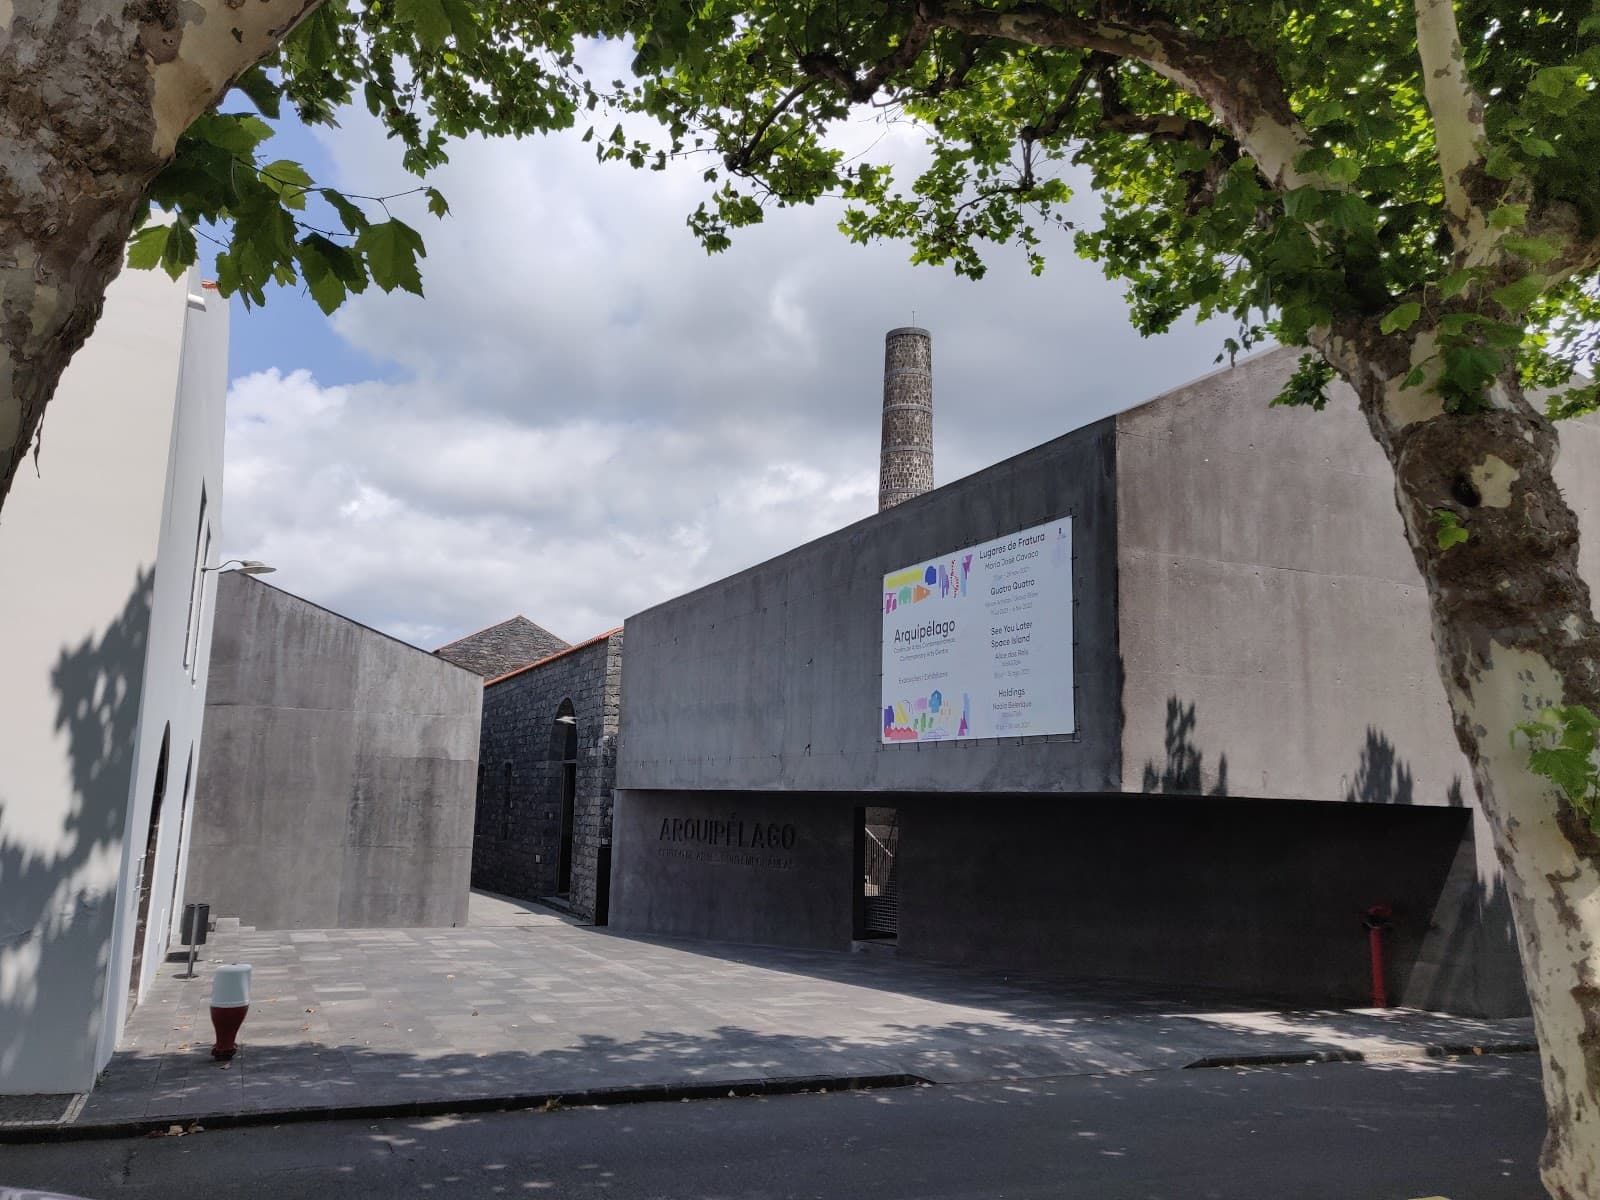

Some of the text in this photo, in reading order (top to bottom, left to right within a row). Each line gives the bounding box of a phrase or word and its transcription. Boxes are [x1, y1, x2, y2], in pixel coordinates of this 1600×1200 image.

[979, 545, 1007, 560] Lugares
[1007, 541, 1017, 551] de
[1018, 533, 1045, 547] Fratura
[990, 579, 1035, 596] Quatro Quatro
[894, 620, 956, 644] Arquipélago
[991, 621, 1033, 636] See You Later
[991, 634, 1031, 649] Space Island
[998, 688, 1026, 698] Holdings
[659, 812, 796, 850] ARQUIPÉLAGO
